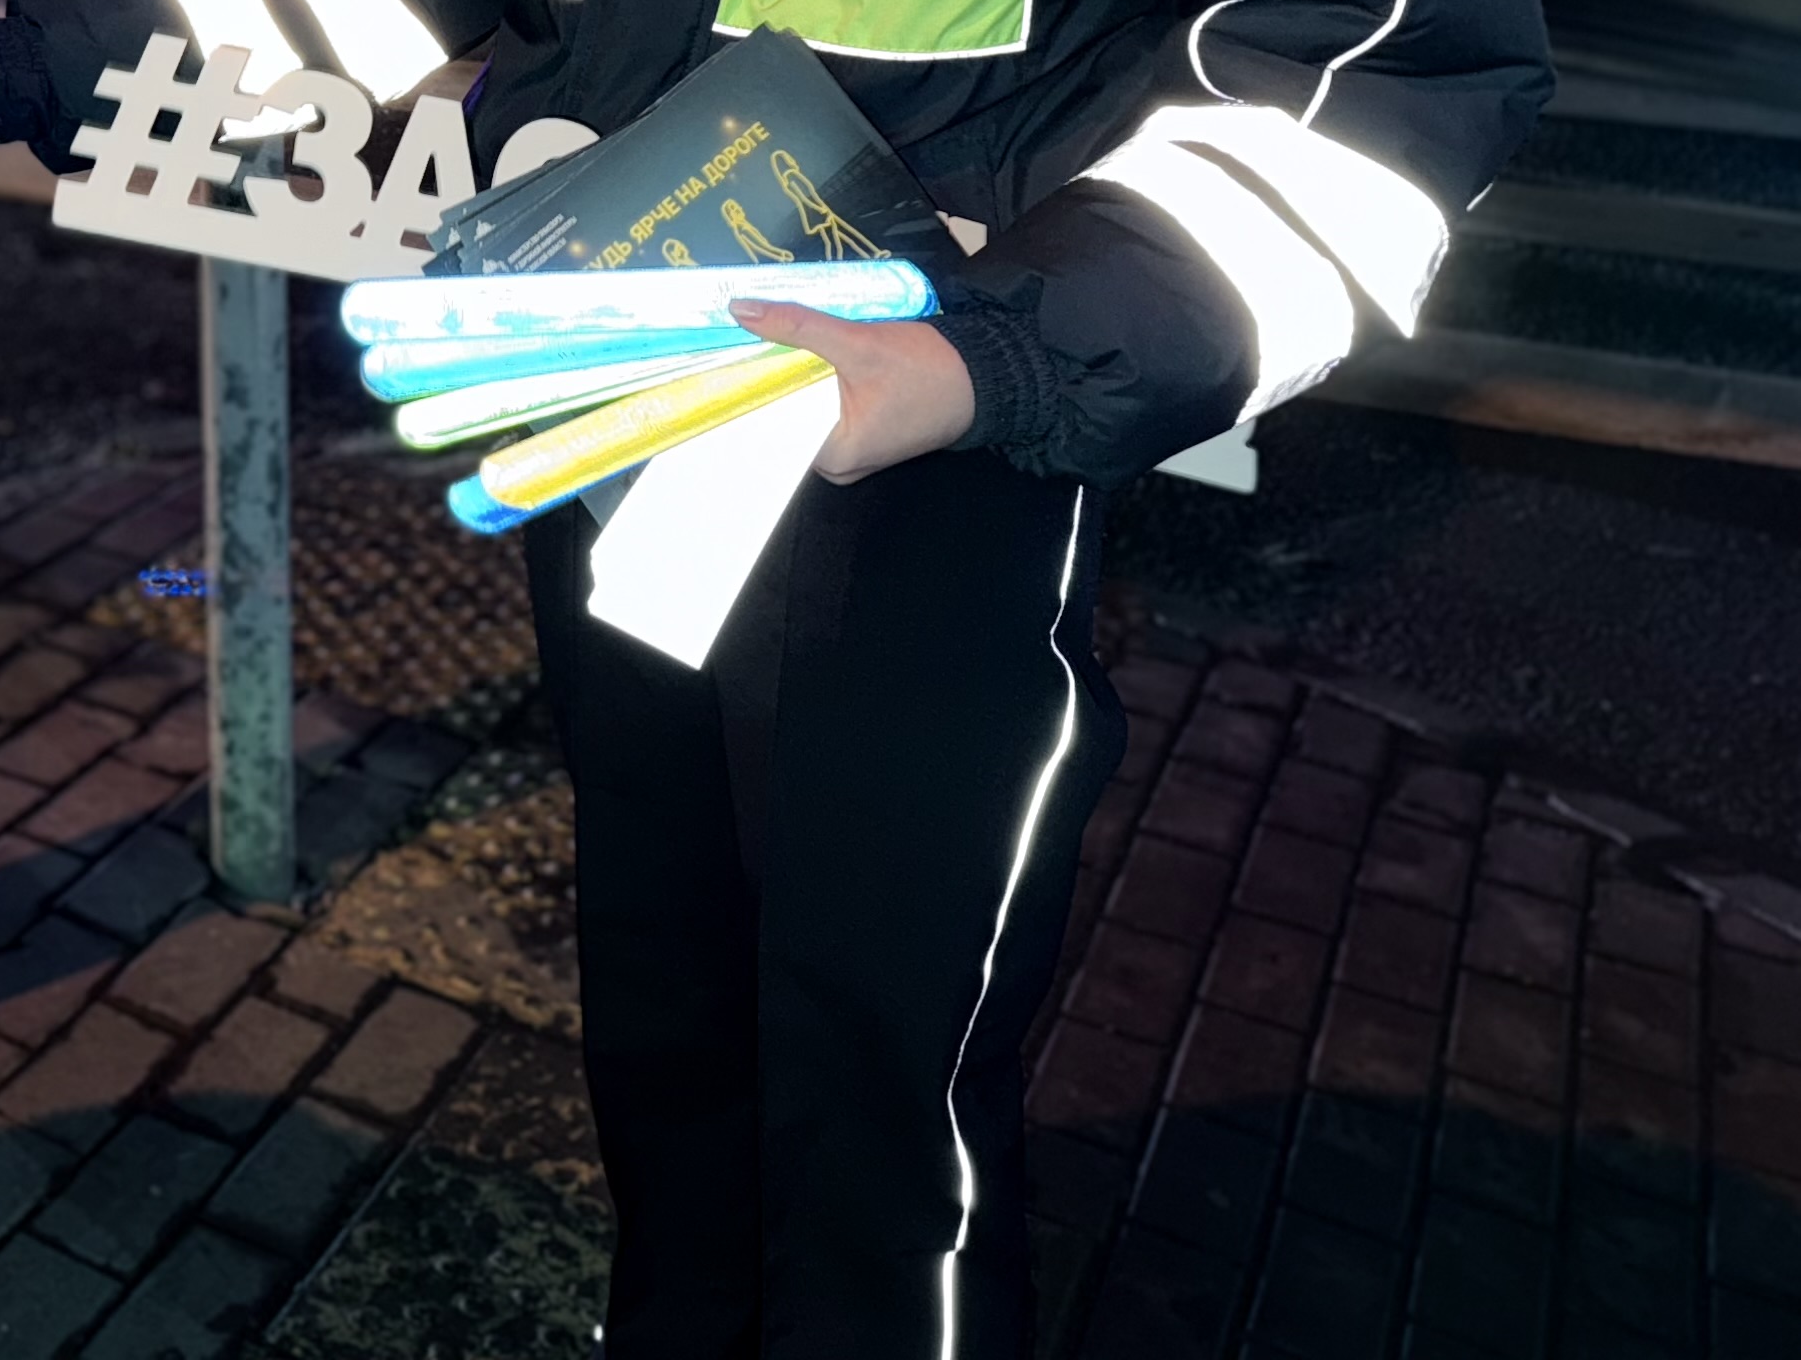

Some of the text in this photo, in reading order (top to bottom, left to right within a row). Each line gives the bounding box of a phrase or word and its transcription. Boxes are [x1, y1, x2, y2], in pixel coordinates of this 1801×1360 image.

[584, 239, 632, 269] УДЬ
[629, 195, 682, 244] ЯРЧЕ
[674, 176, 708, 206] НА
[701, 121, 770, 187] ДОРОГЕ
